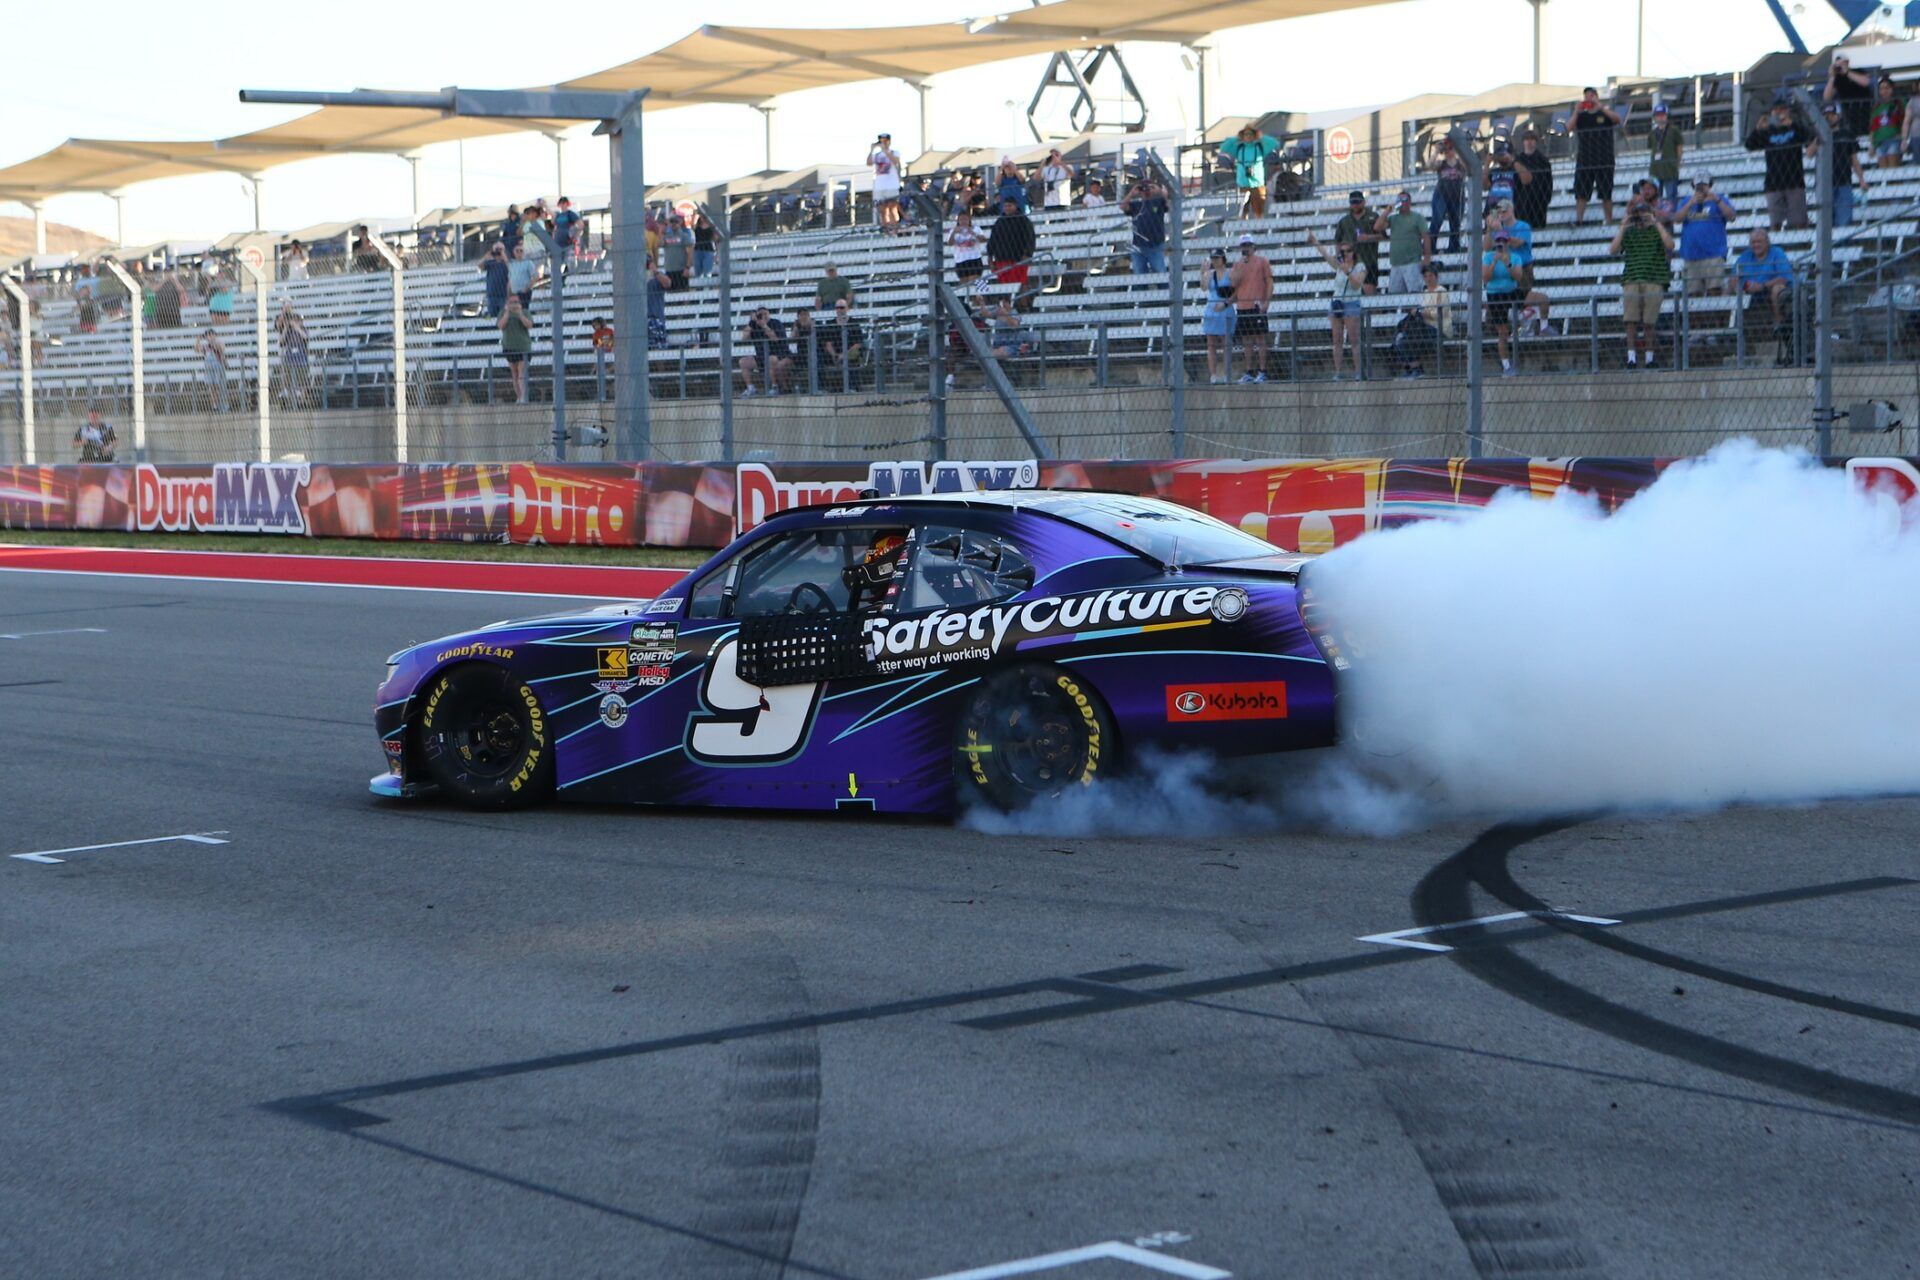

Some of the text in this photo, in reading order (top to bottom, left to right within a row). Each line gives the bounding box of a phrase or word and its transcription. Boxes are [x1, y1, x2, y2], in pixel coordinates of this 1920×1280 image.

[866, 585, 1217, 656] SafetyCulture
[437, 643, 514, 663] GOODYEAR
[630, 651, 673, 661] COMETIC
[876, 646, 990, 672] etter way of working
[638, 676, 666, 687] MSD
[424, 677, 449, 728] EAGLE
[688, 637, 820, 760] 9
[1209, 692, 1279, 710] Kubota
